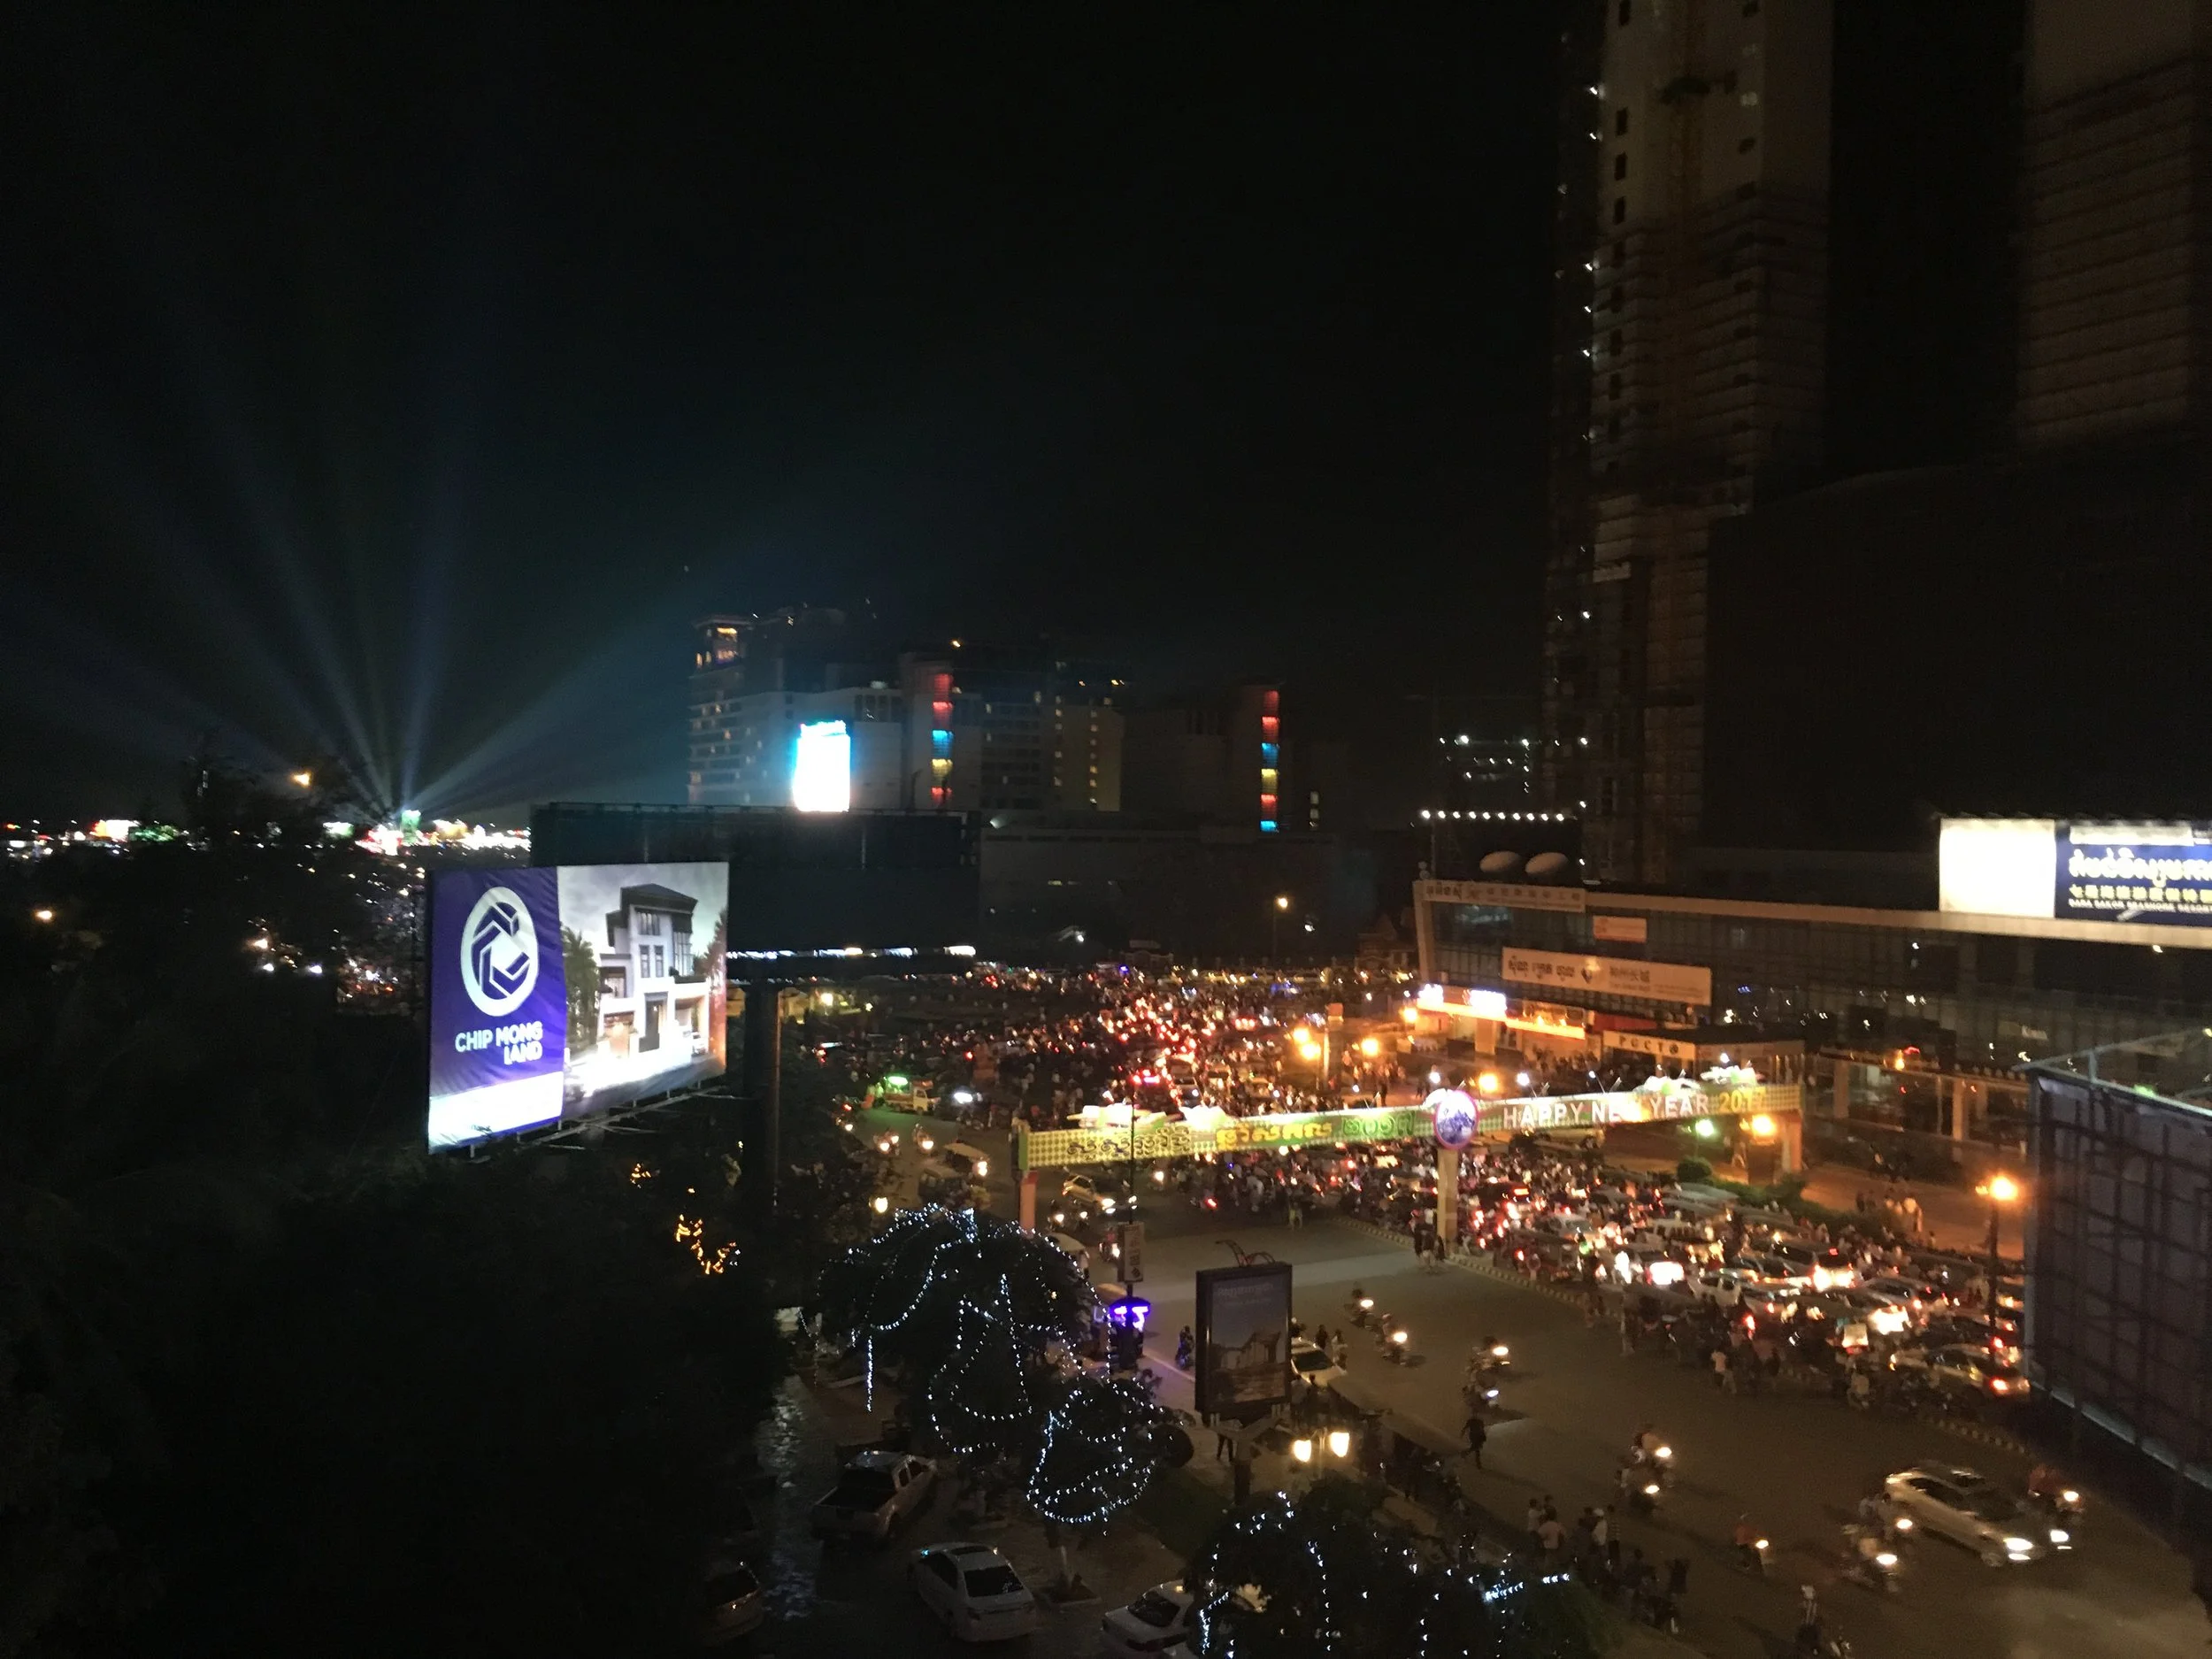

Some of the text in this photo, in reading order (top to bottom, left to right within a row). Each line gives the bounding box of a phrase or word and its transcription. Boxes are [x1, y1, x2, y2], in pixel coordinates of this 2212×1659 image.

[455, 1021, 543, 1053] CHIP MONG
[503, 1040, 543, 1065] LAND
[1503, 1102, 1585, 1129] HAPPY
[1650, 1092, 1709, 1119] YEAR
[1719, 1087, 1767, 1112] 2017
